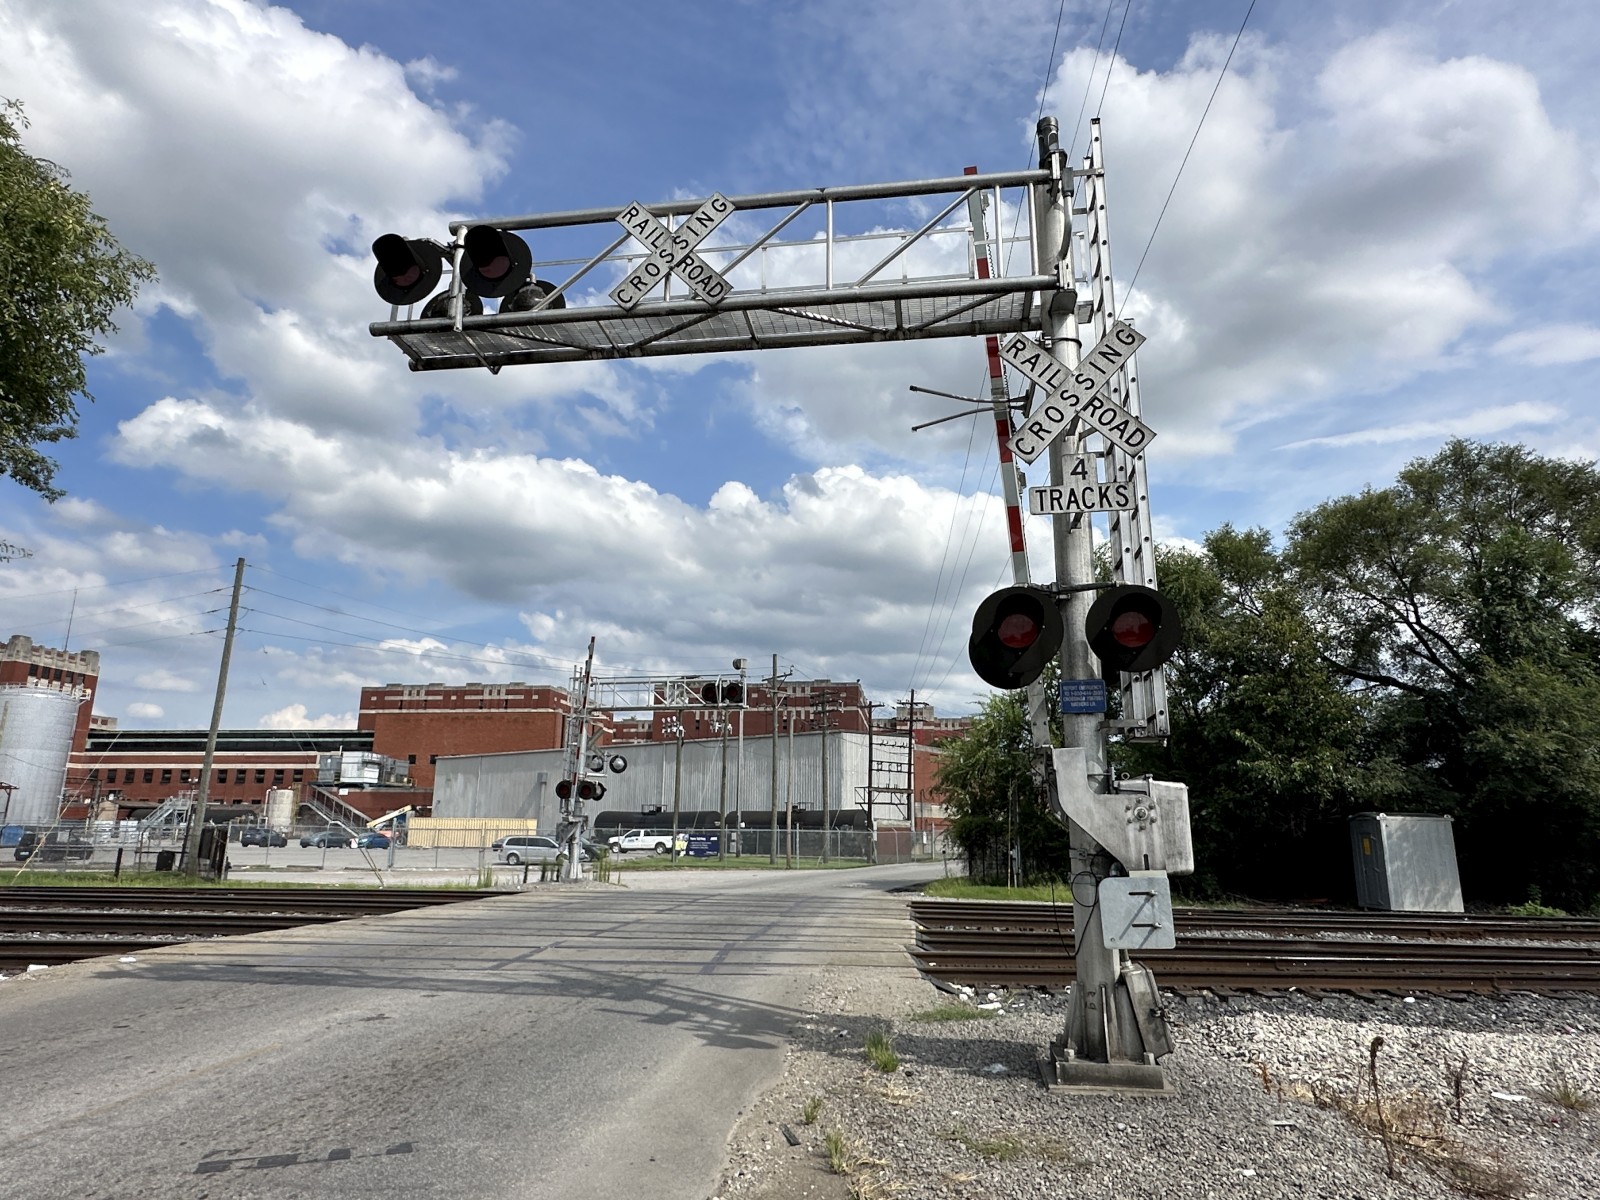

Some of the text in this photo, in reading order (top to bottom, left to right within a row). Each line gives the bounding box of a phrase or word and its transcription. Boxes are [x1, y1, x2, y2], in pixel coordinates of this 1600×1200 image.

[617, 199, 727, 304] CROSSING
[1015, 328, 1136, 456] CROSSING
[1035, 485, 1129, 511] TRACKS
[1070, 459, 1088, 480] 4
